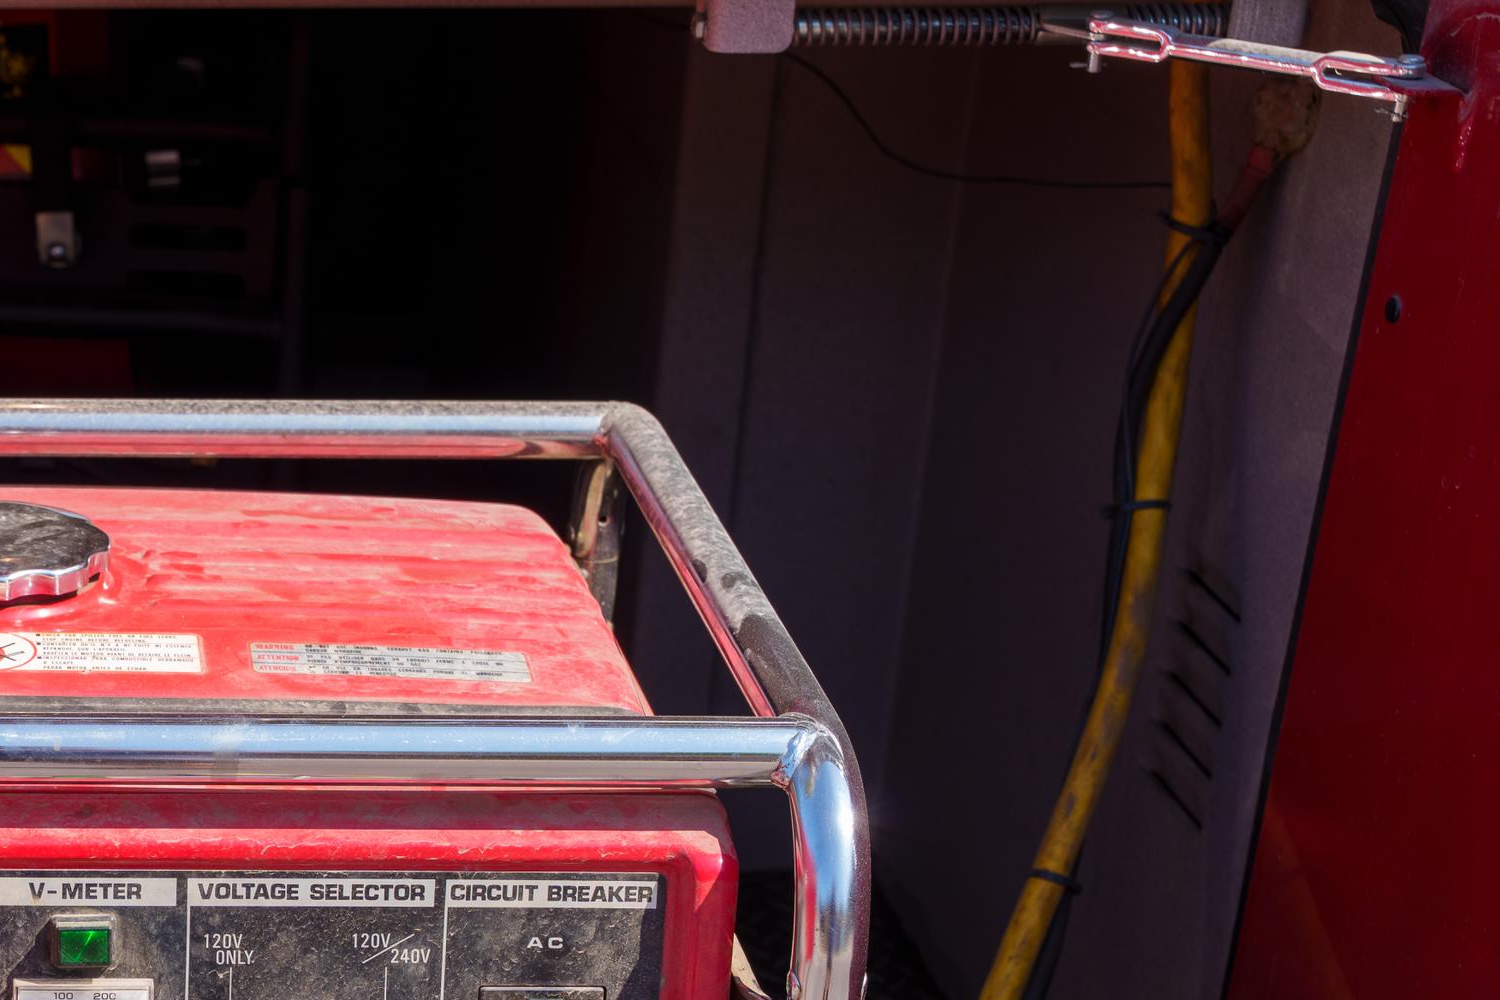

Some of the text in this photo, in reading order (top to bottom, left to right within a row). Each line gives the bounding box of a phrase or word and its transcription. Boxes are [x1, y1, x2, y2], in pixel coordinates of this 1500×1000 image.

[28, 882, 143, 901] V-METER
[198, 882, 426, 902] VOLTAGE SELECTOR
[449, 884, 654, 904] CIRCUIT BREAKER
[203, 932, 243, 949] 120V
[527, 936, 564, 950] AC
[215, 949, 254, 966] ONLY
[54, 992, 74, 1000] 100
[93, 992, 117, 1000] 200
